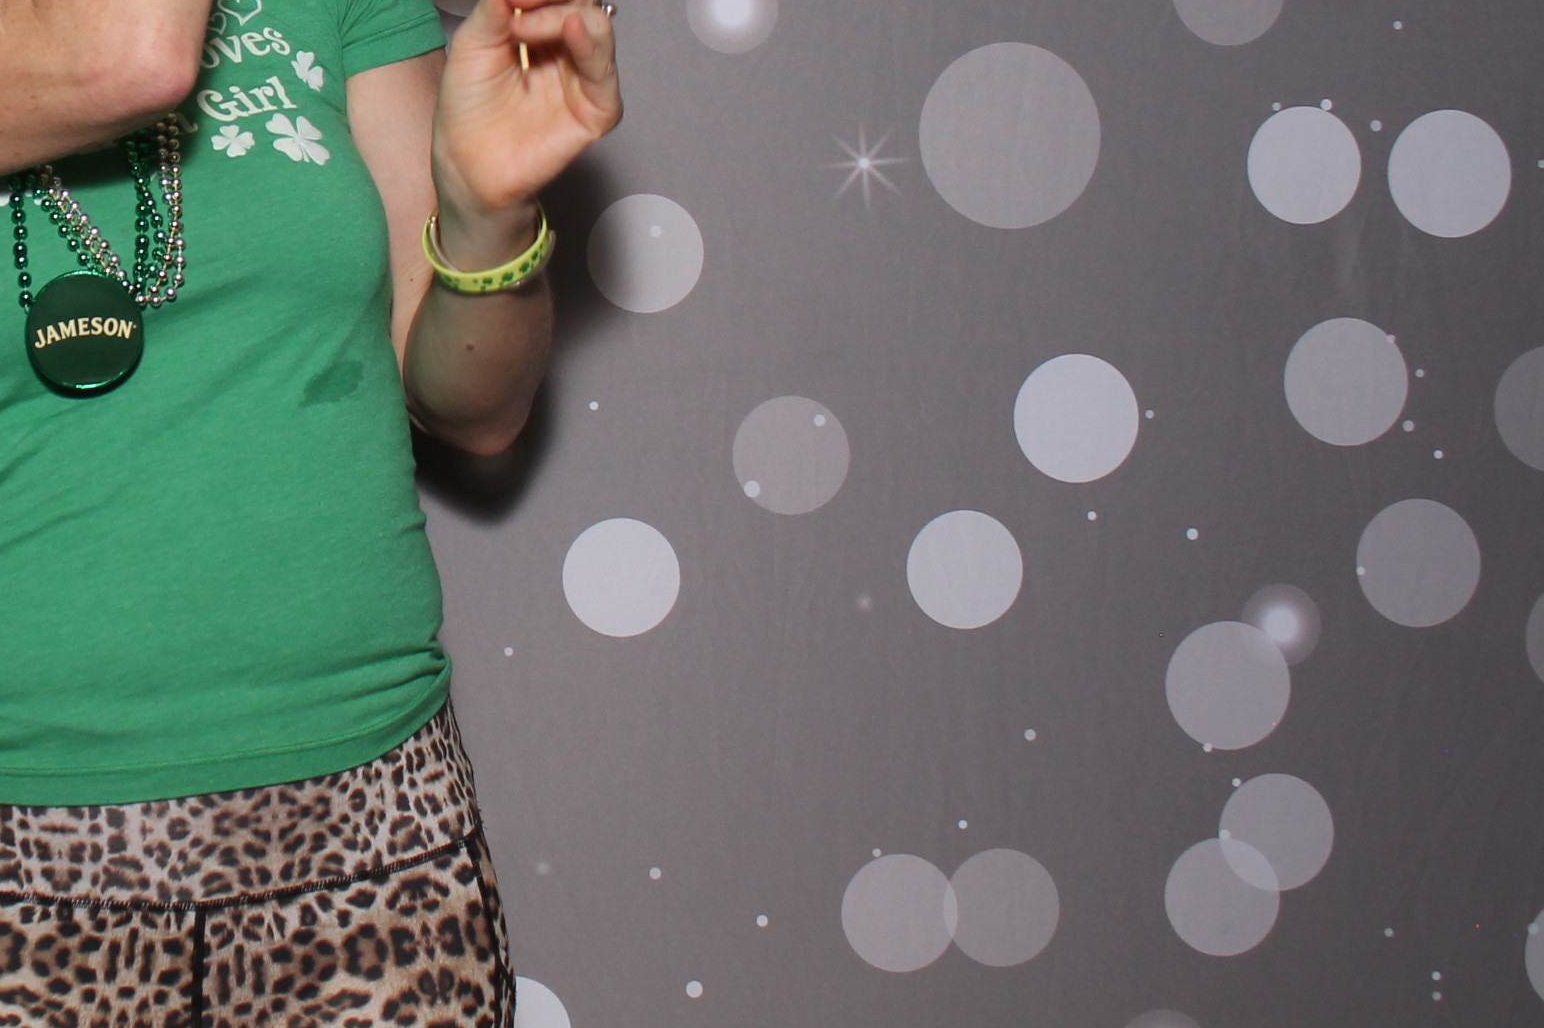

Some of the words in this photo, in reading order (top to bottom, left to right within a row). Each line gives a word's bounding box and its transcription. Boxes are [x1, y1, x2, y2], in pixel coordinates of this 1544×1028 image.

[200, 27, 291, 69] oves
[197, 75, 298, 122] Girl
[34, 316, 133, 350] JAMESON
